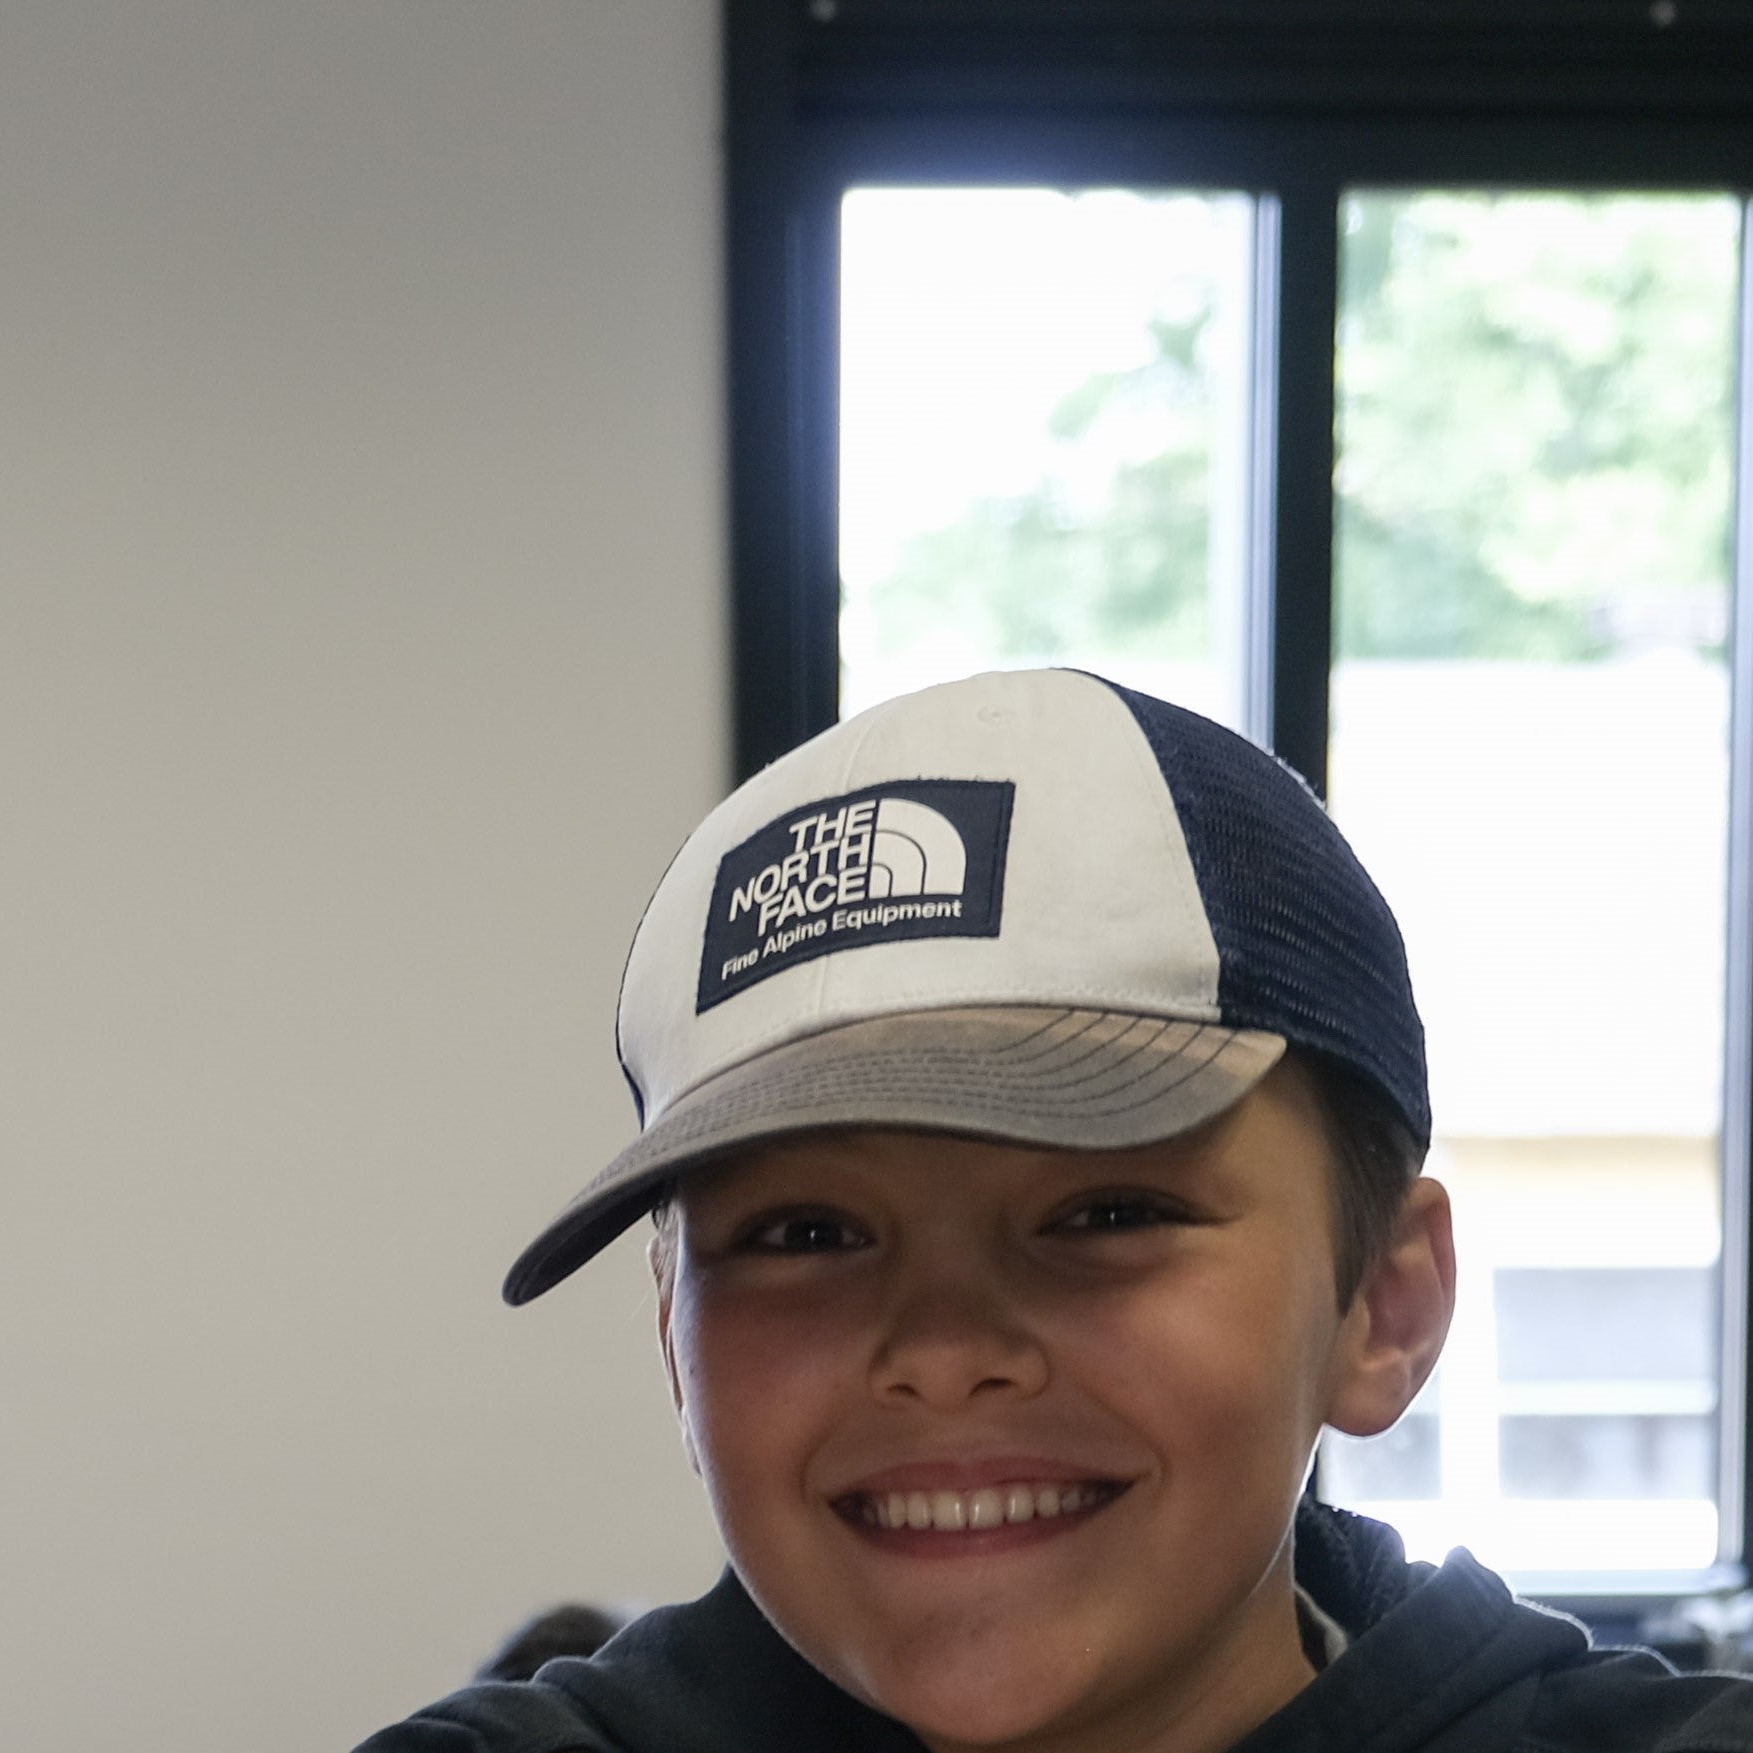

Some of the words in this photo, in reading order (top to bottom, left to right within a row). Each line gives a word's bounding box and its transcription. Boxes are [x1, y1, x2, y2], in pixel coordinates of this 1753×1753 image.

[789, 800, 876, 854] THE
[729, 832, 872, 922] NORTH
[757, 866, 867, 936] FACE
[721, 948, 759, 981] Fine
[763, 915, 827, 960] Alpine
[832, 899, 963, 931] Equipment
